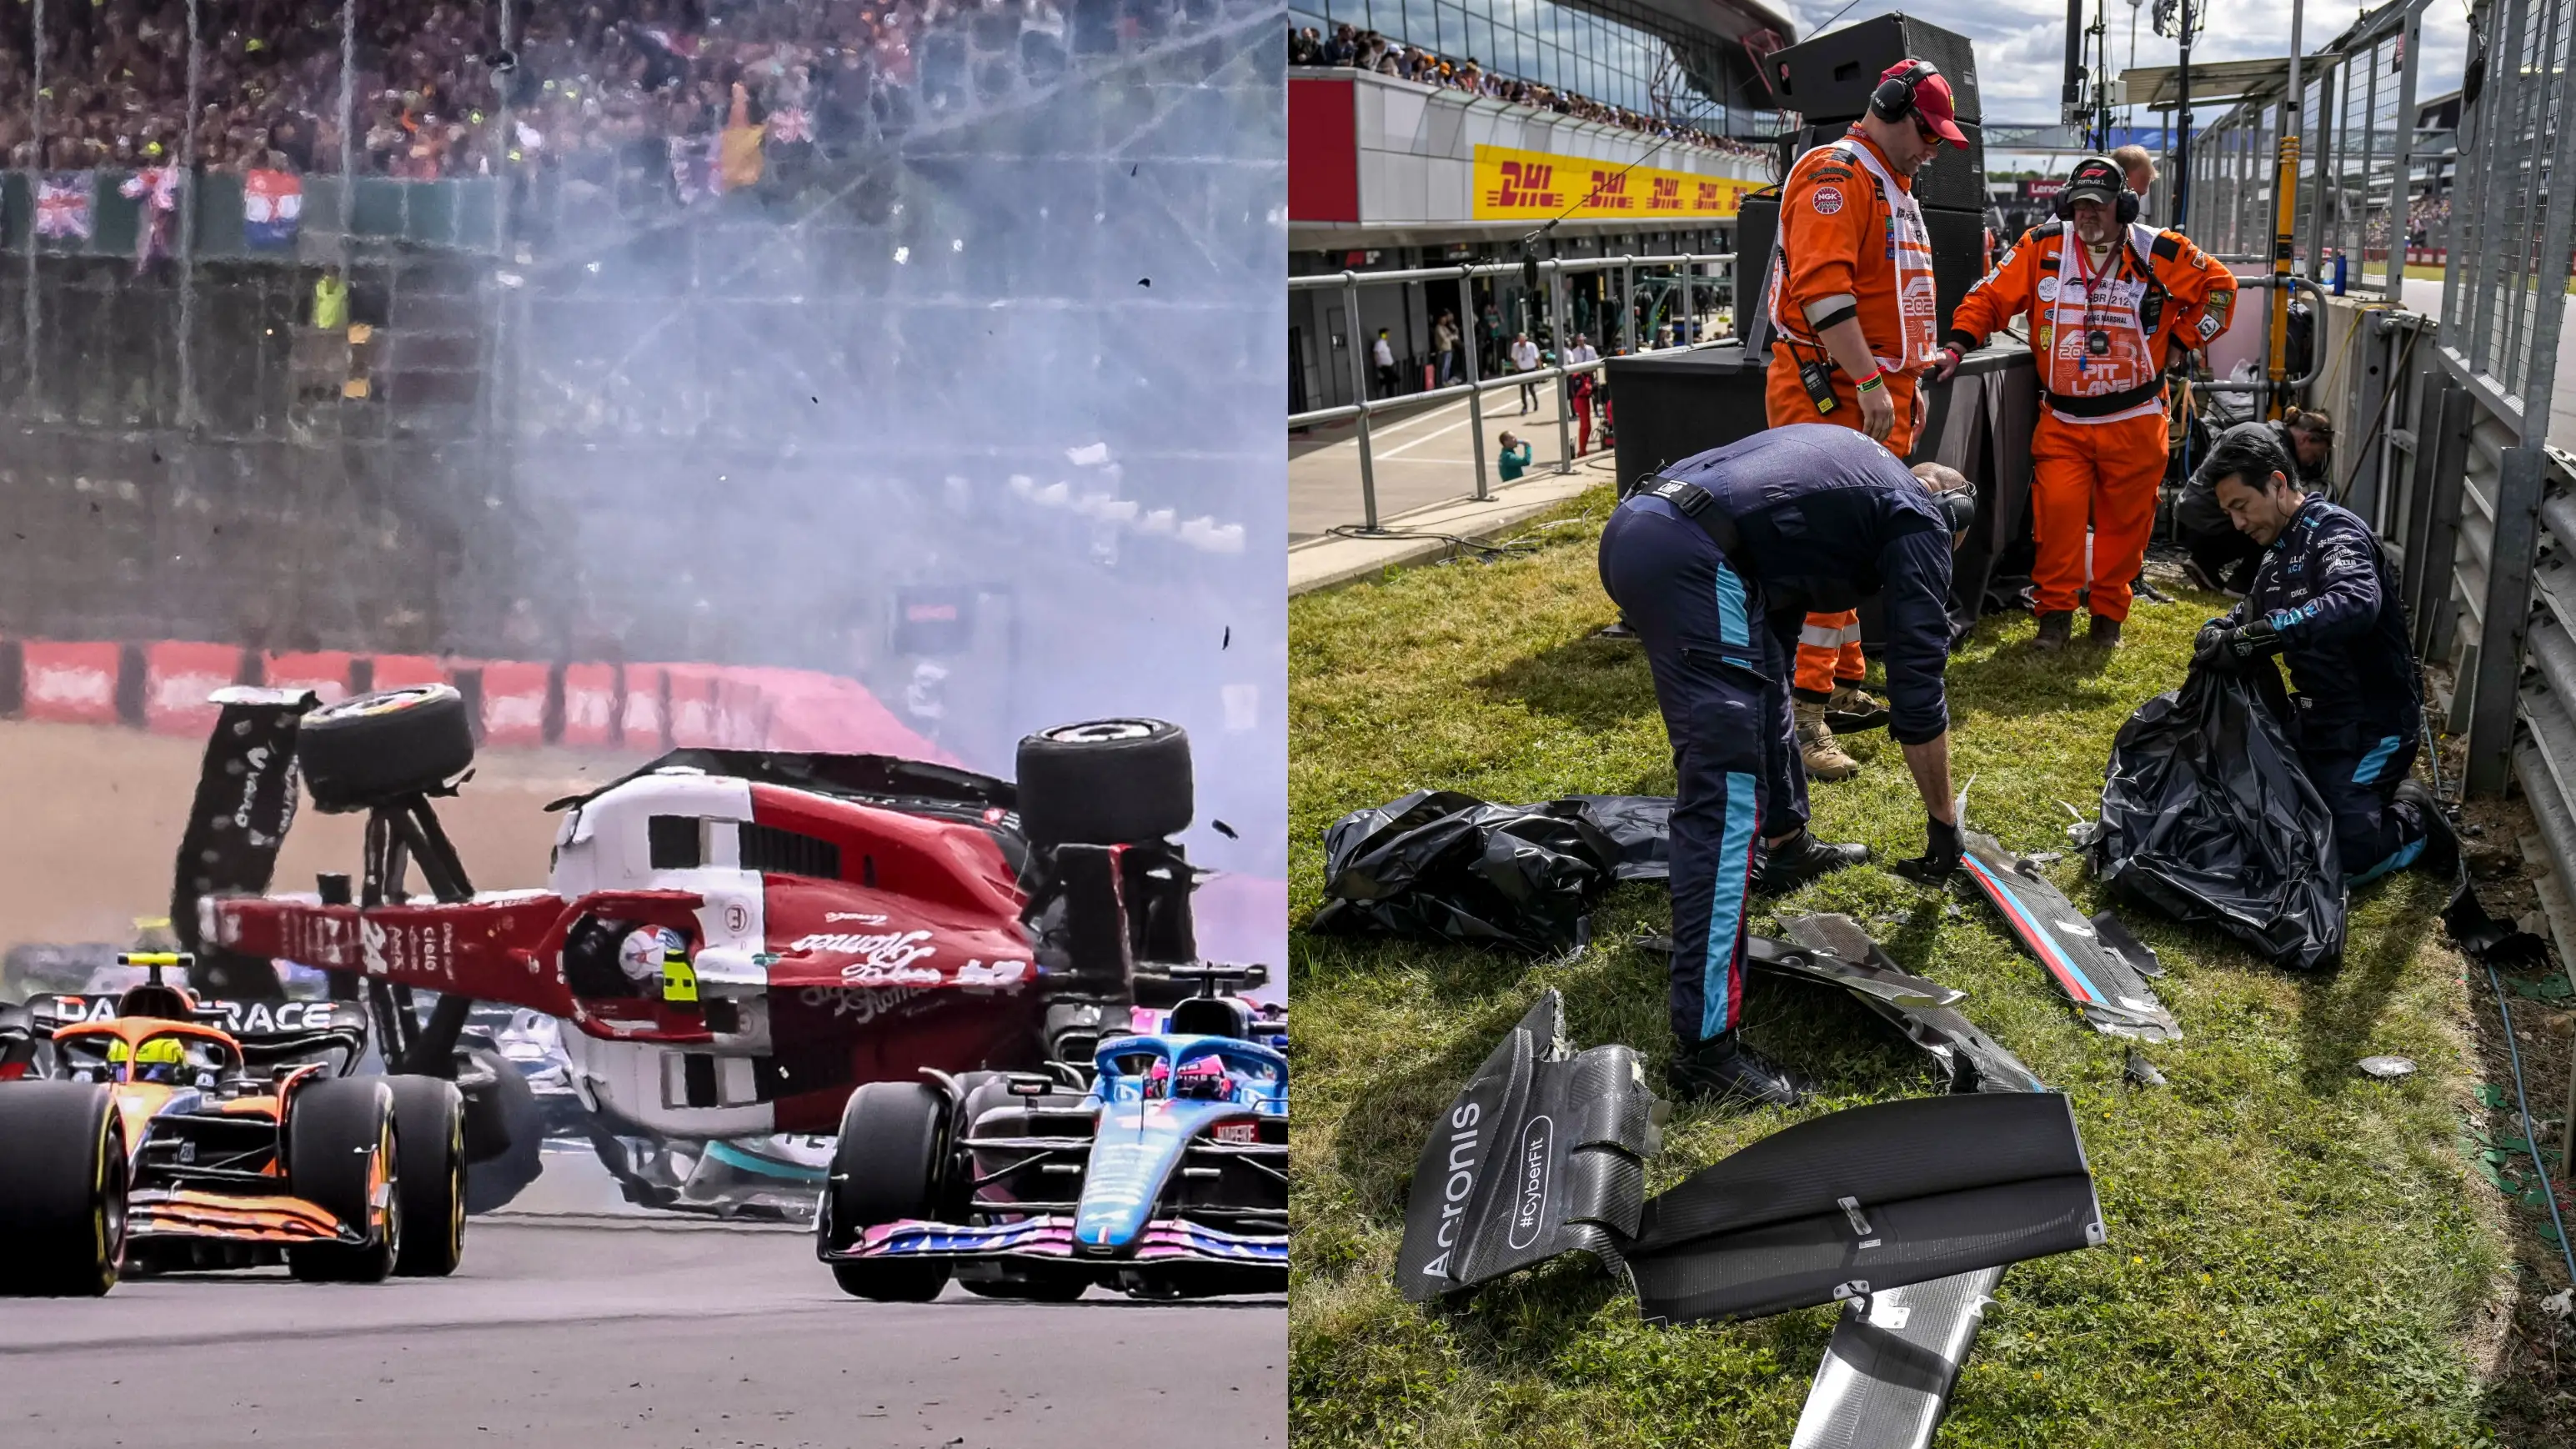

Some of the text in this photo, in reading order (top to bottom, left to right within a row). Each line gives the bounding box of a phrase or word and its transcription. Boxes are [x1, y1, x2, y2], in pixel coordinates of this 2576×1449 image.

[1500, 161, 1553, 207] DHL
[1591, 170, 1627, 208] DHL
[1654, 177, 1680, 209] DHL
[2031, 183, 2063, 193] Leno
[1902, 298, 1935, 316] 202
[2111, 296, 2130, 306] 212
[2102, 315, 2127, 323] MARSHAL
[2072, 379, 2131, 396] LANE
[2082, 364, 2119, 379] PIT
[1656, 481, 1685, 494] OMP
[360, 916, 388, 974] 24
[424, 927, 438, 970] cielo
[56, 997, 335, 1032] DARACE
[1422, 1102, 1480, 1278] Acronis
[1520, 1137, 1544, 1227] #CyberFit
